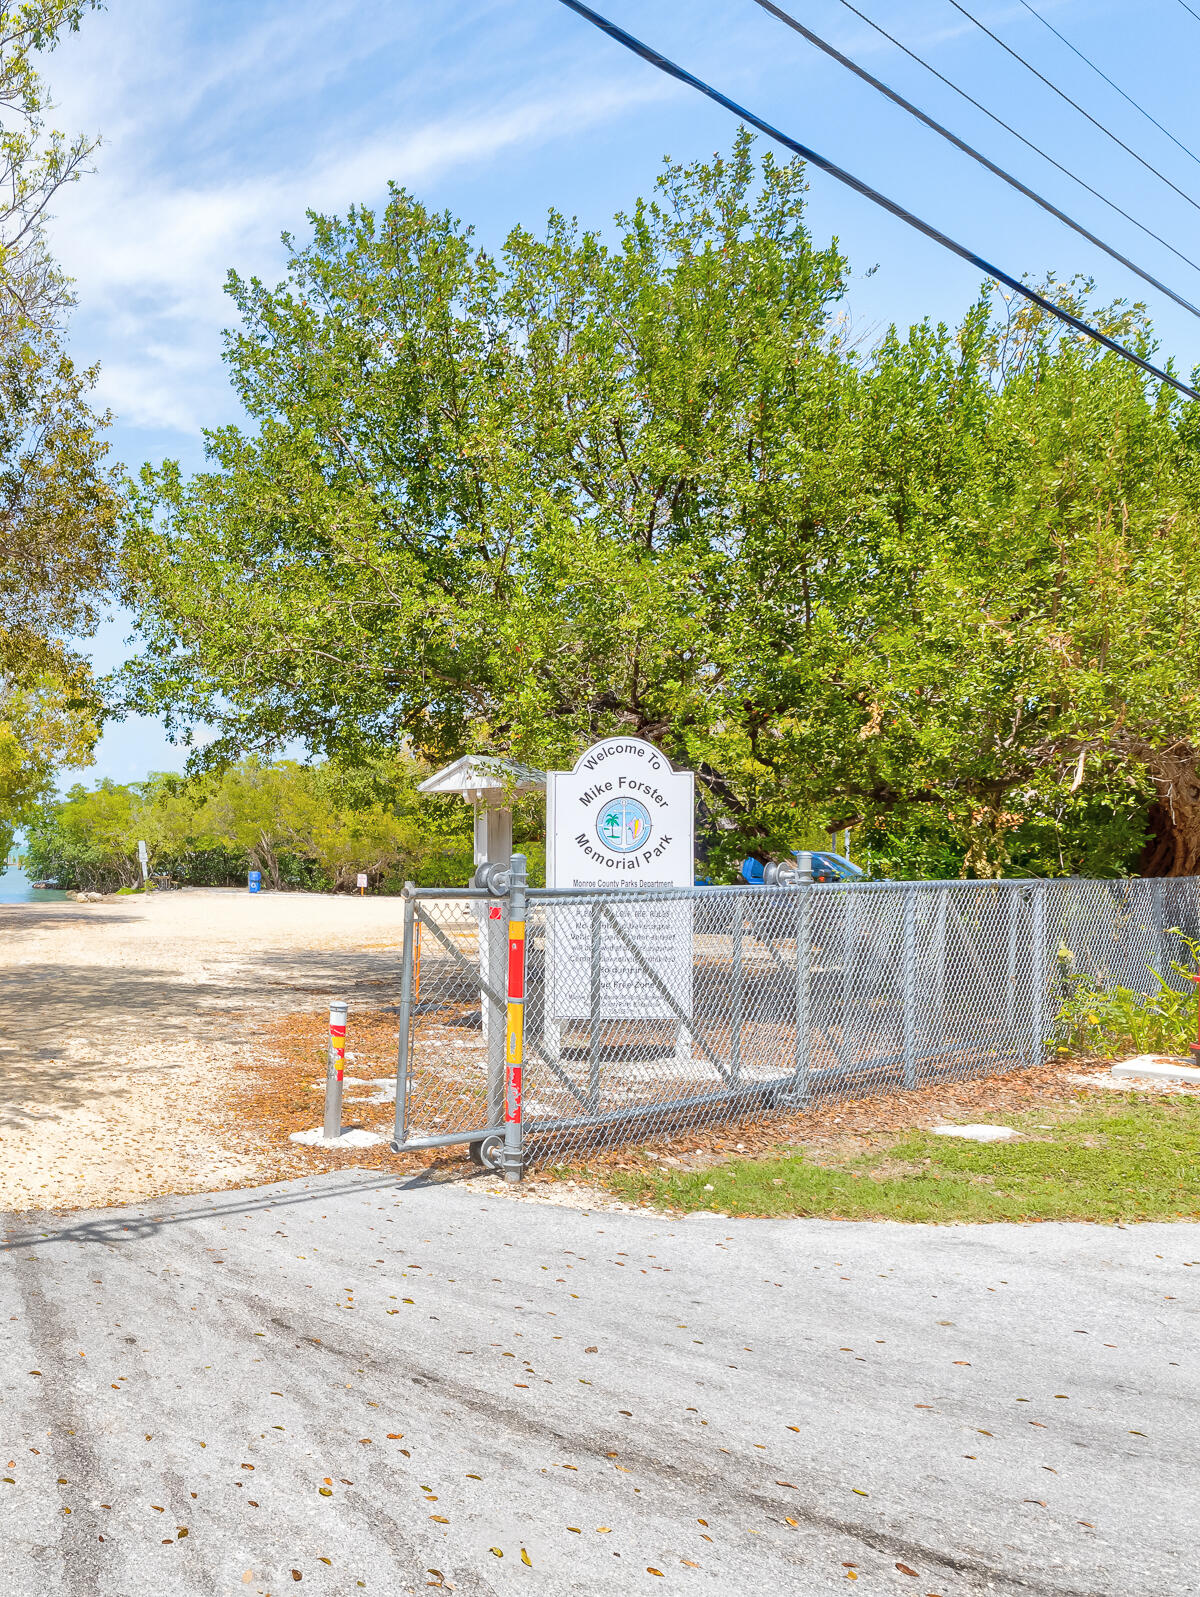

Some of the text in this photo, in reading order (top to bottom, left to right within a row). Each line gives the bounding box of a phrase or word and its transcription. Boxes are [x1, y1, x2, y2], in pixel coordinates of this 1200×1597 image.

[583, 744, 661, 771] Welcome To
[579, 776, 669, 809] Mike Forster
[574, 833, 673, 870] Memorial Park
[573, 879, 674, 888] Monroe County Parks Department
